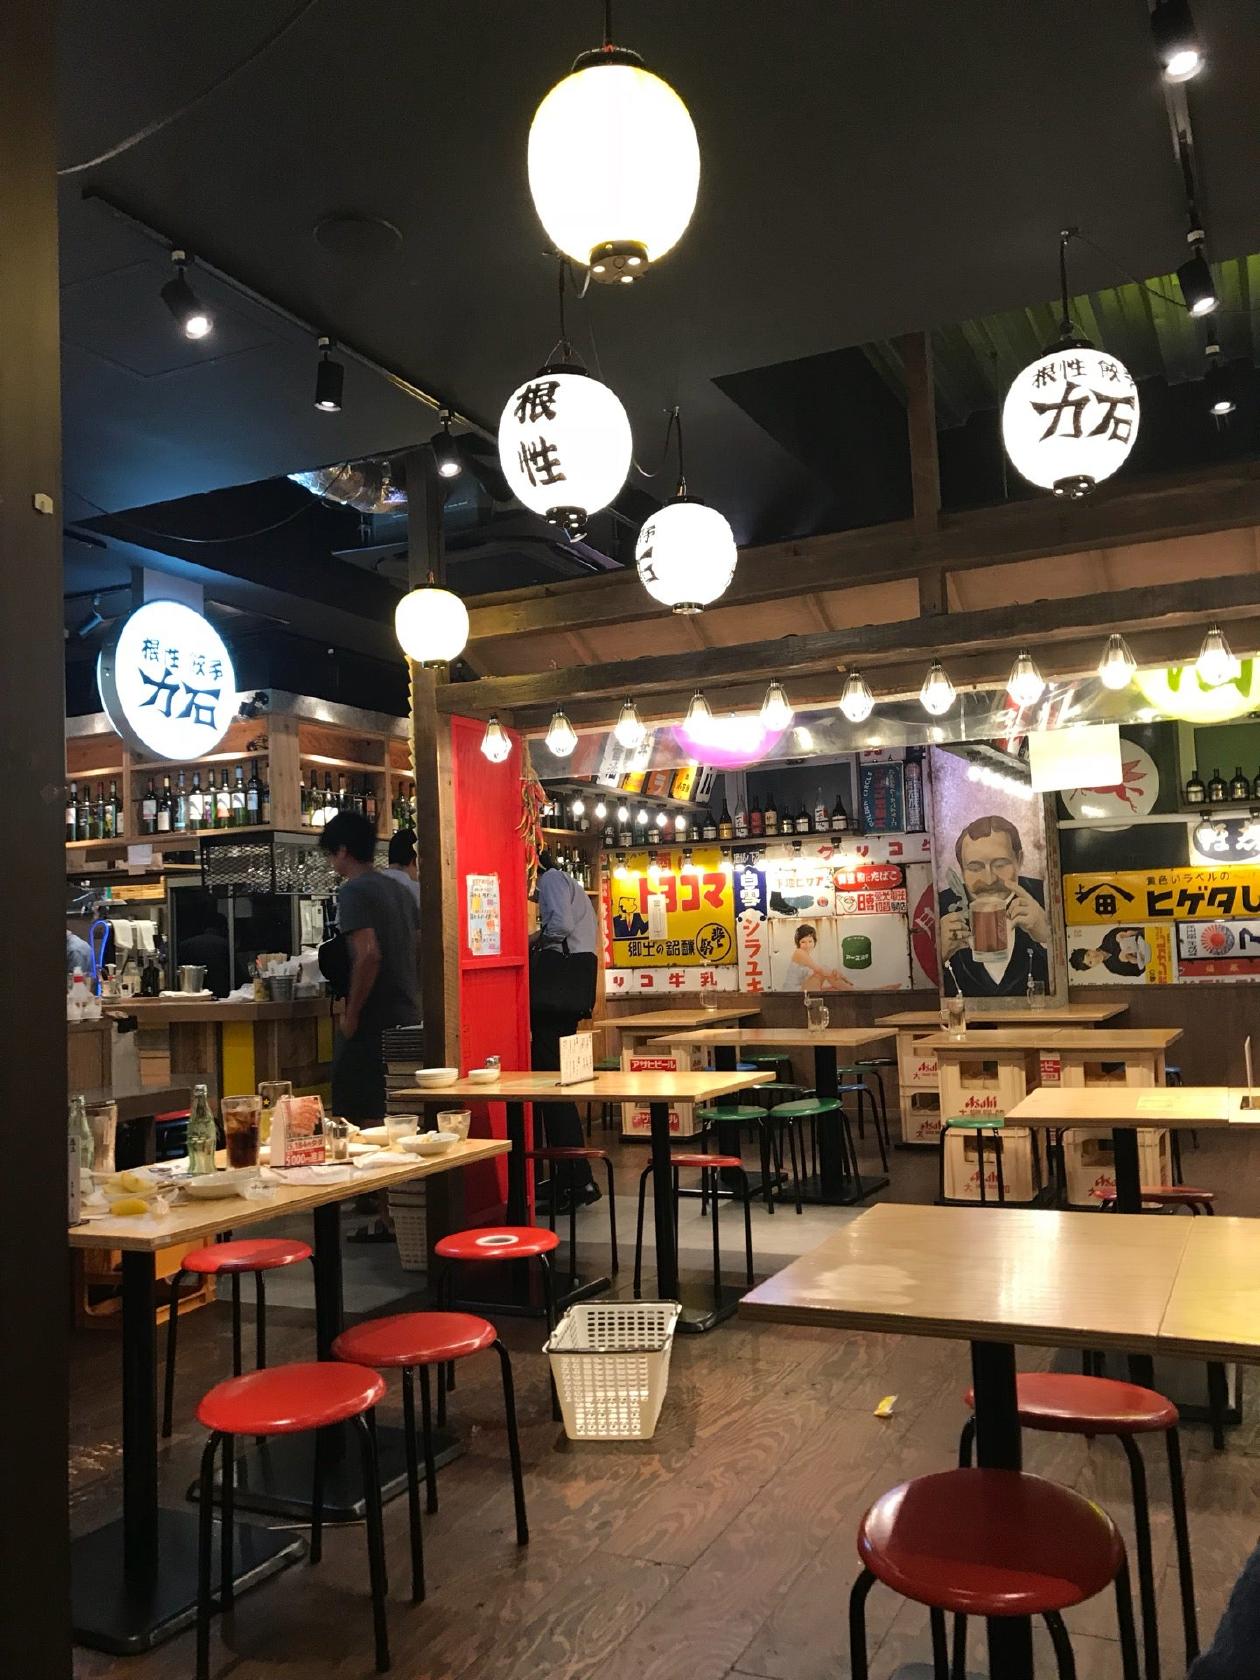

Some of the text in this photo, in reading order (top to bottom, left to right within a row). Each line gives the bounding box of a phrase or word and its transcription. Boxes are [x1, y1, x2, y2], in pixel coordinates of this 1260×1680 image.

[514, 380, 567, 487] 根性
[1029, 380, 1136, 445] 力石
[136, 667, 221, 731] 力石
[1147, 871, 1230, 886] 黄色いラベルの
[742, 918, 764, 992] シラユキ
[631, 1059, 676, 1070] アサヒビール
[965, 1096, 998, 1109] Asahi
